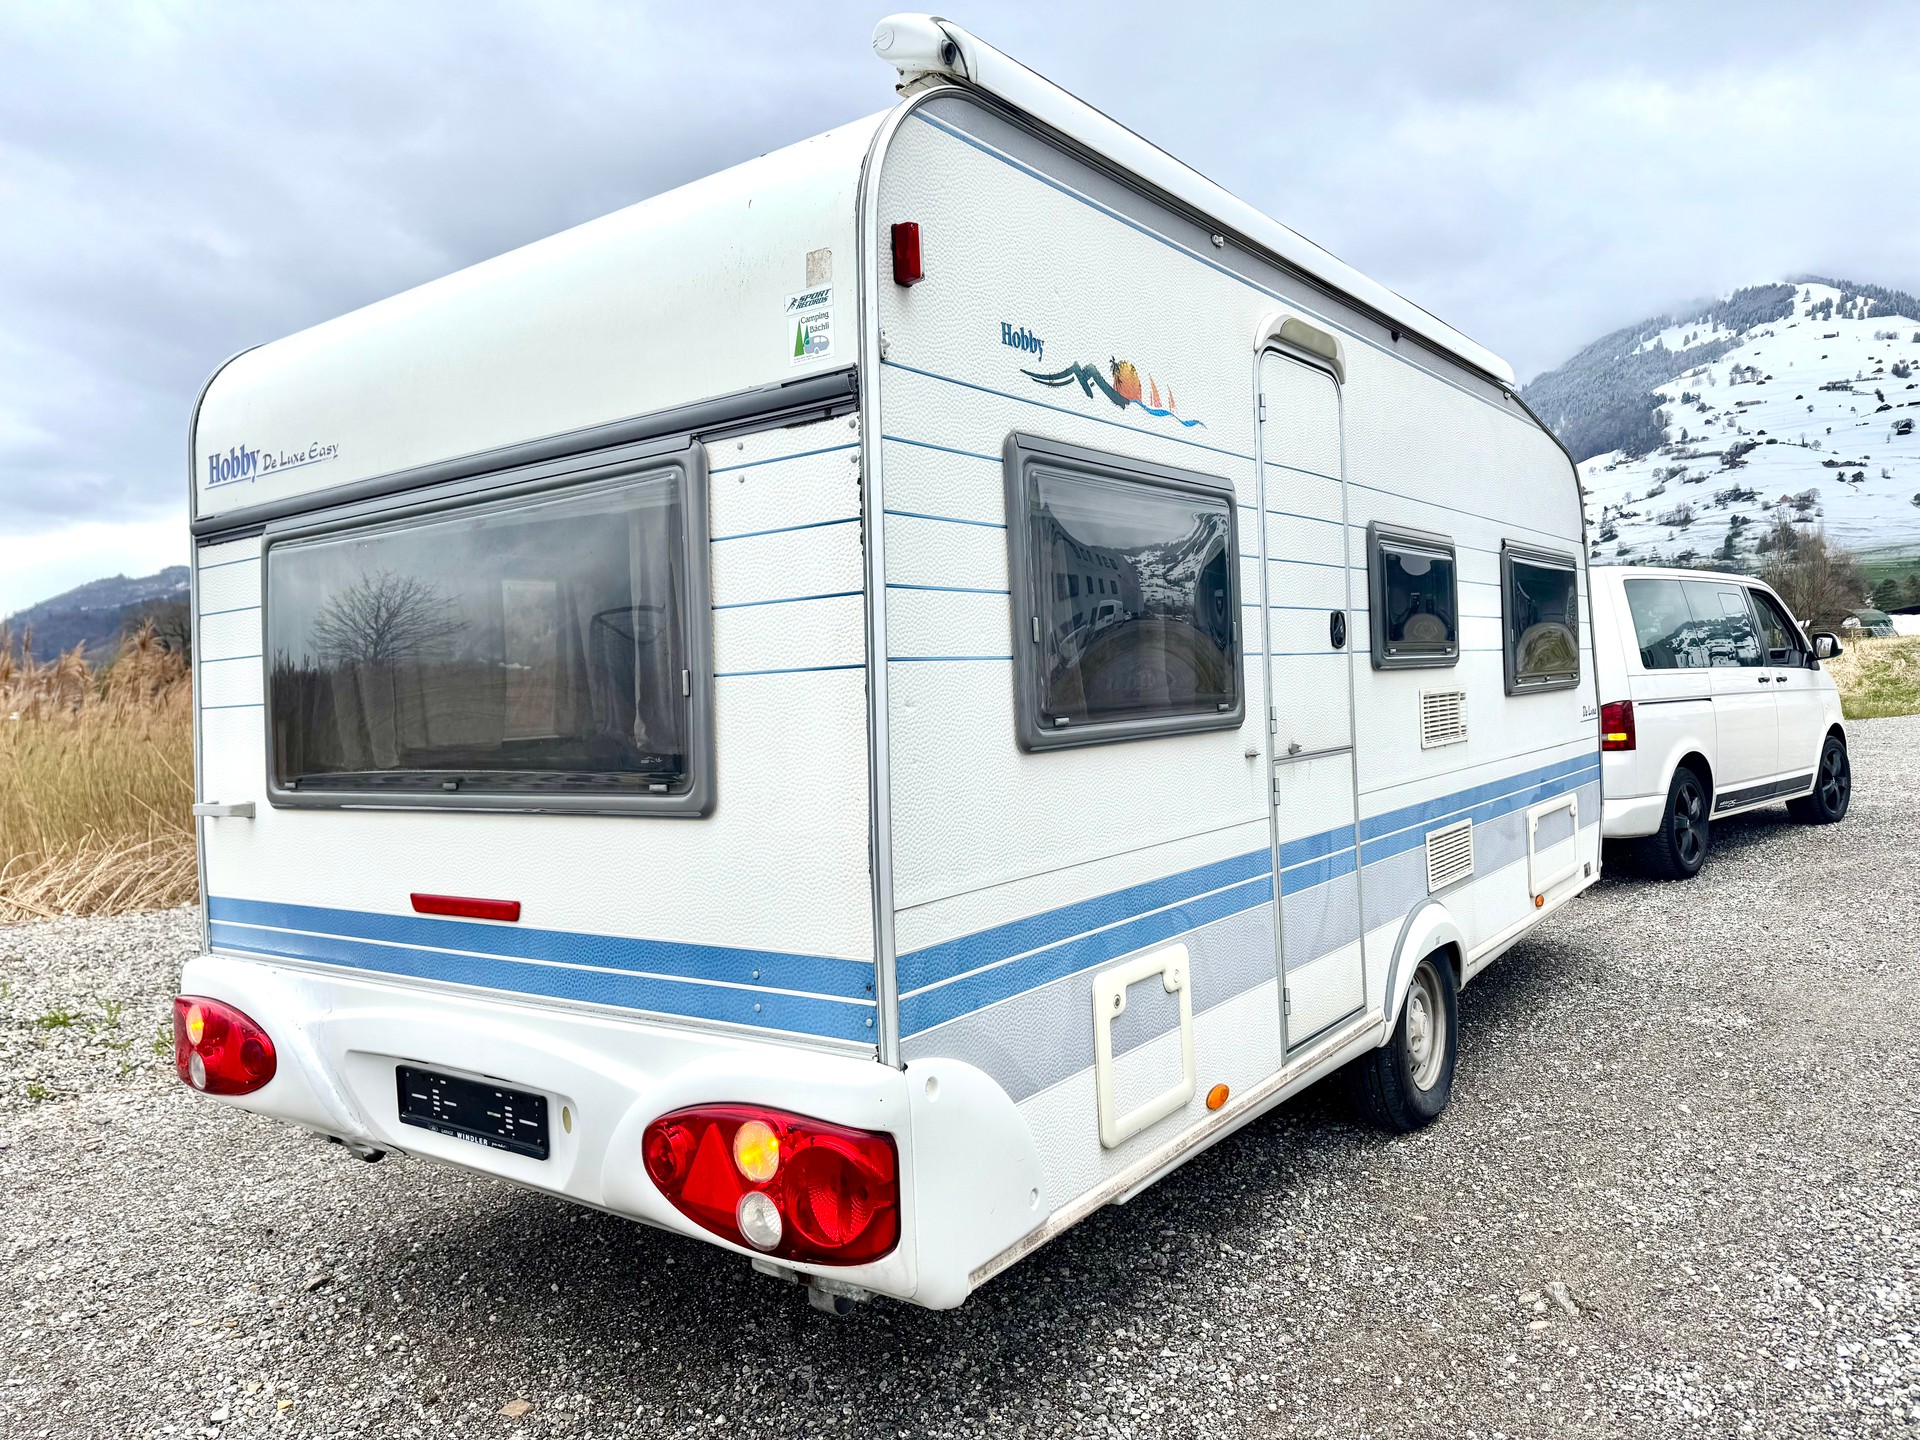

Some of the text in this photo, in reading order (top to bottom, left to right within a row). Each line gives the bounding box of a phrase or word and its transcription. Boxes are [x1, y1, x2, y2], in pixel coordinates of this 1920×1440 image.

[799, 288, 831, 301] SPORT
[796, 296, 828, 309] RECORDS
[800, 311, 829, 324] Camping
[1000, 321, 1045, 362] Hobby
[208, 441, 339, 483] Hobby De Luxe Easy
[456, 1131, 488, 1146] WINDLER
